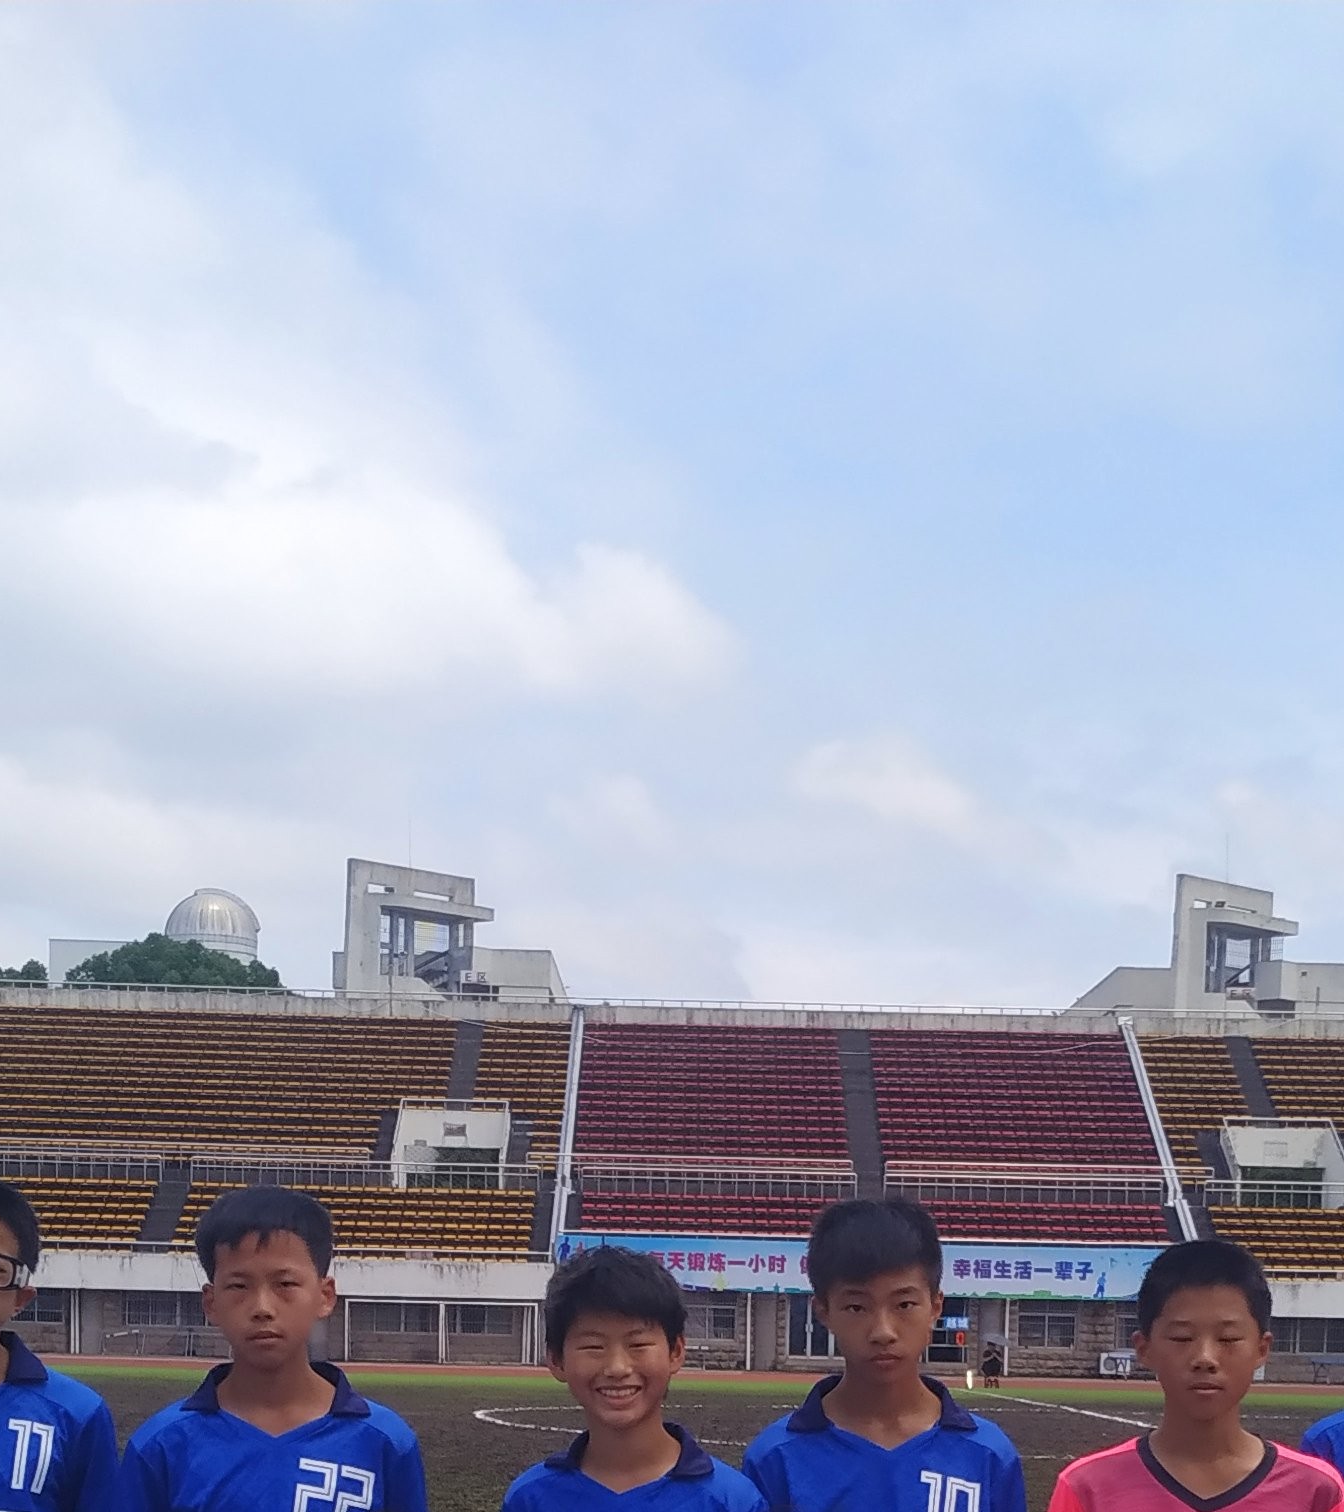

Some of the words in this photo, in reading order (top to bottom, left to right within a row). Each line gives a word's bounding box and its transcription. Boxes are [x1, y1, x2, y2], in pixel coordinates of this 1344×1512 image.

[952, 1259, 1094, 1281] 幸福生活一辈子
